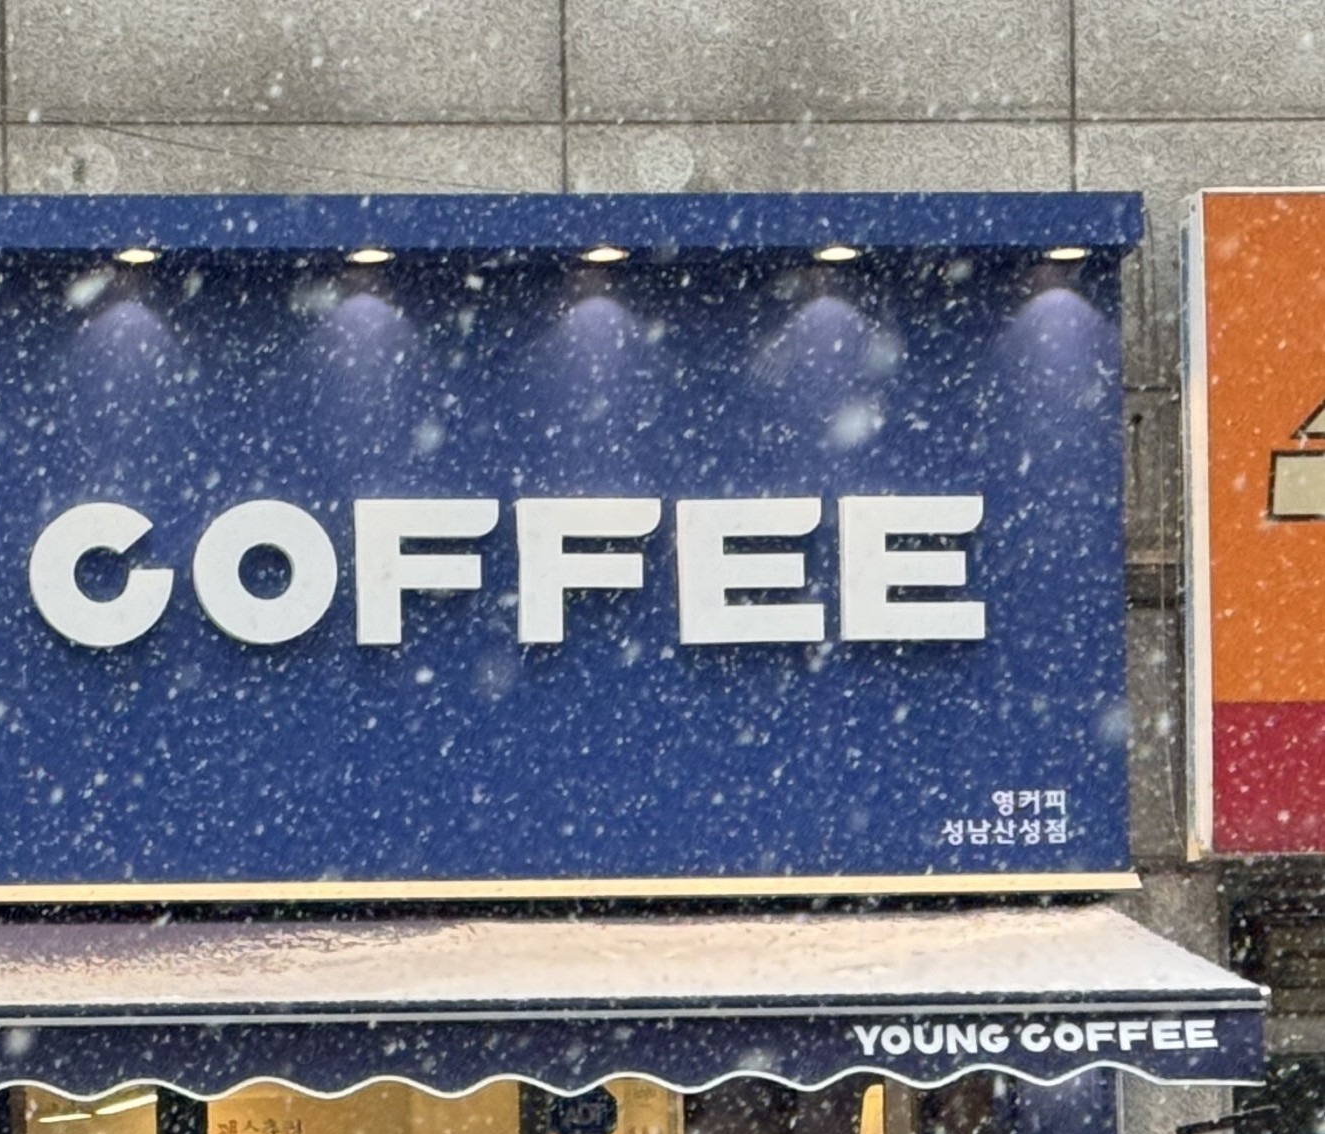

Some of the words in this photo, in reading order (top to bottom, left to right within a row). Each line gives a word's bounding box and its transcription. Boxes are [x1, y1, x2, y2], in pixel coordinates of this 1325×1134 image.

[28, 496, 986, 648] COFFEE
[992, 789, 1067, 816] 영커피
[940, 818, 1067, 846] 성남산성점
[851, 1022, 1010, 1056] YOUNG
[1020, 1019, 1219, 1052] COFFEE
